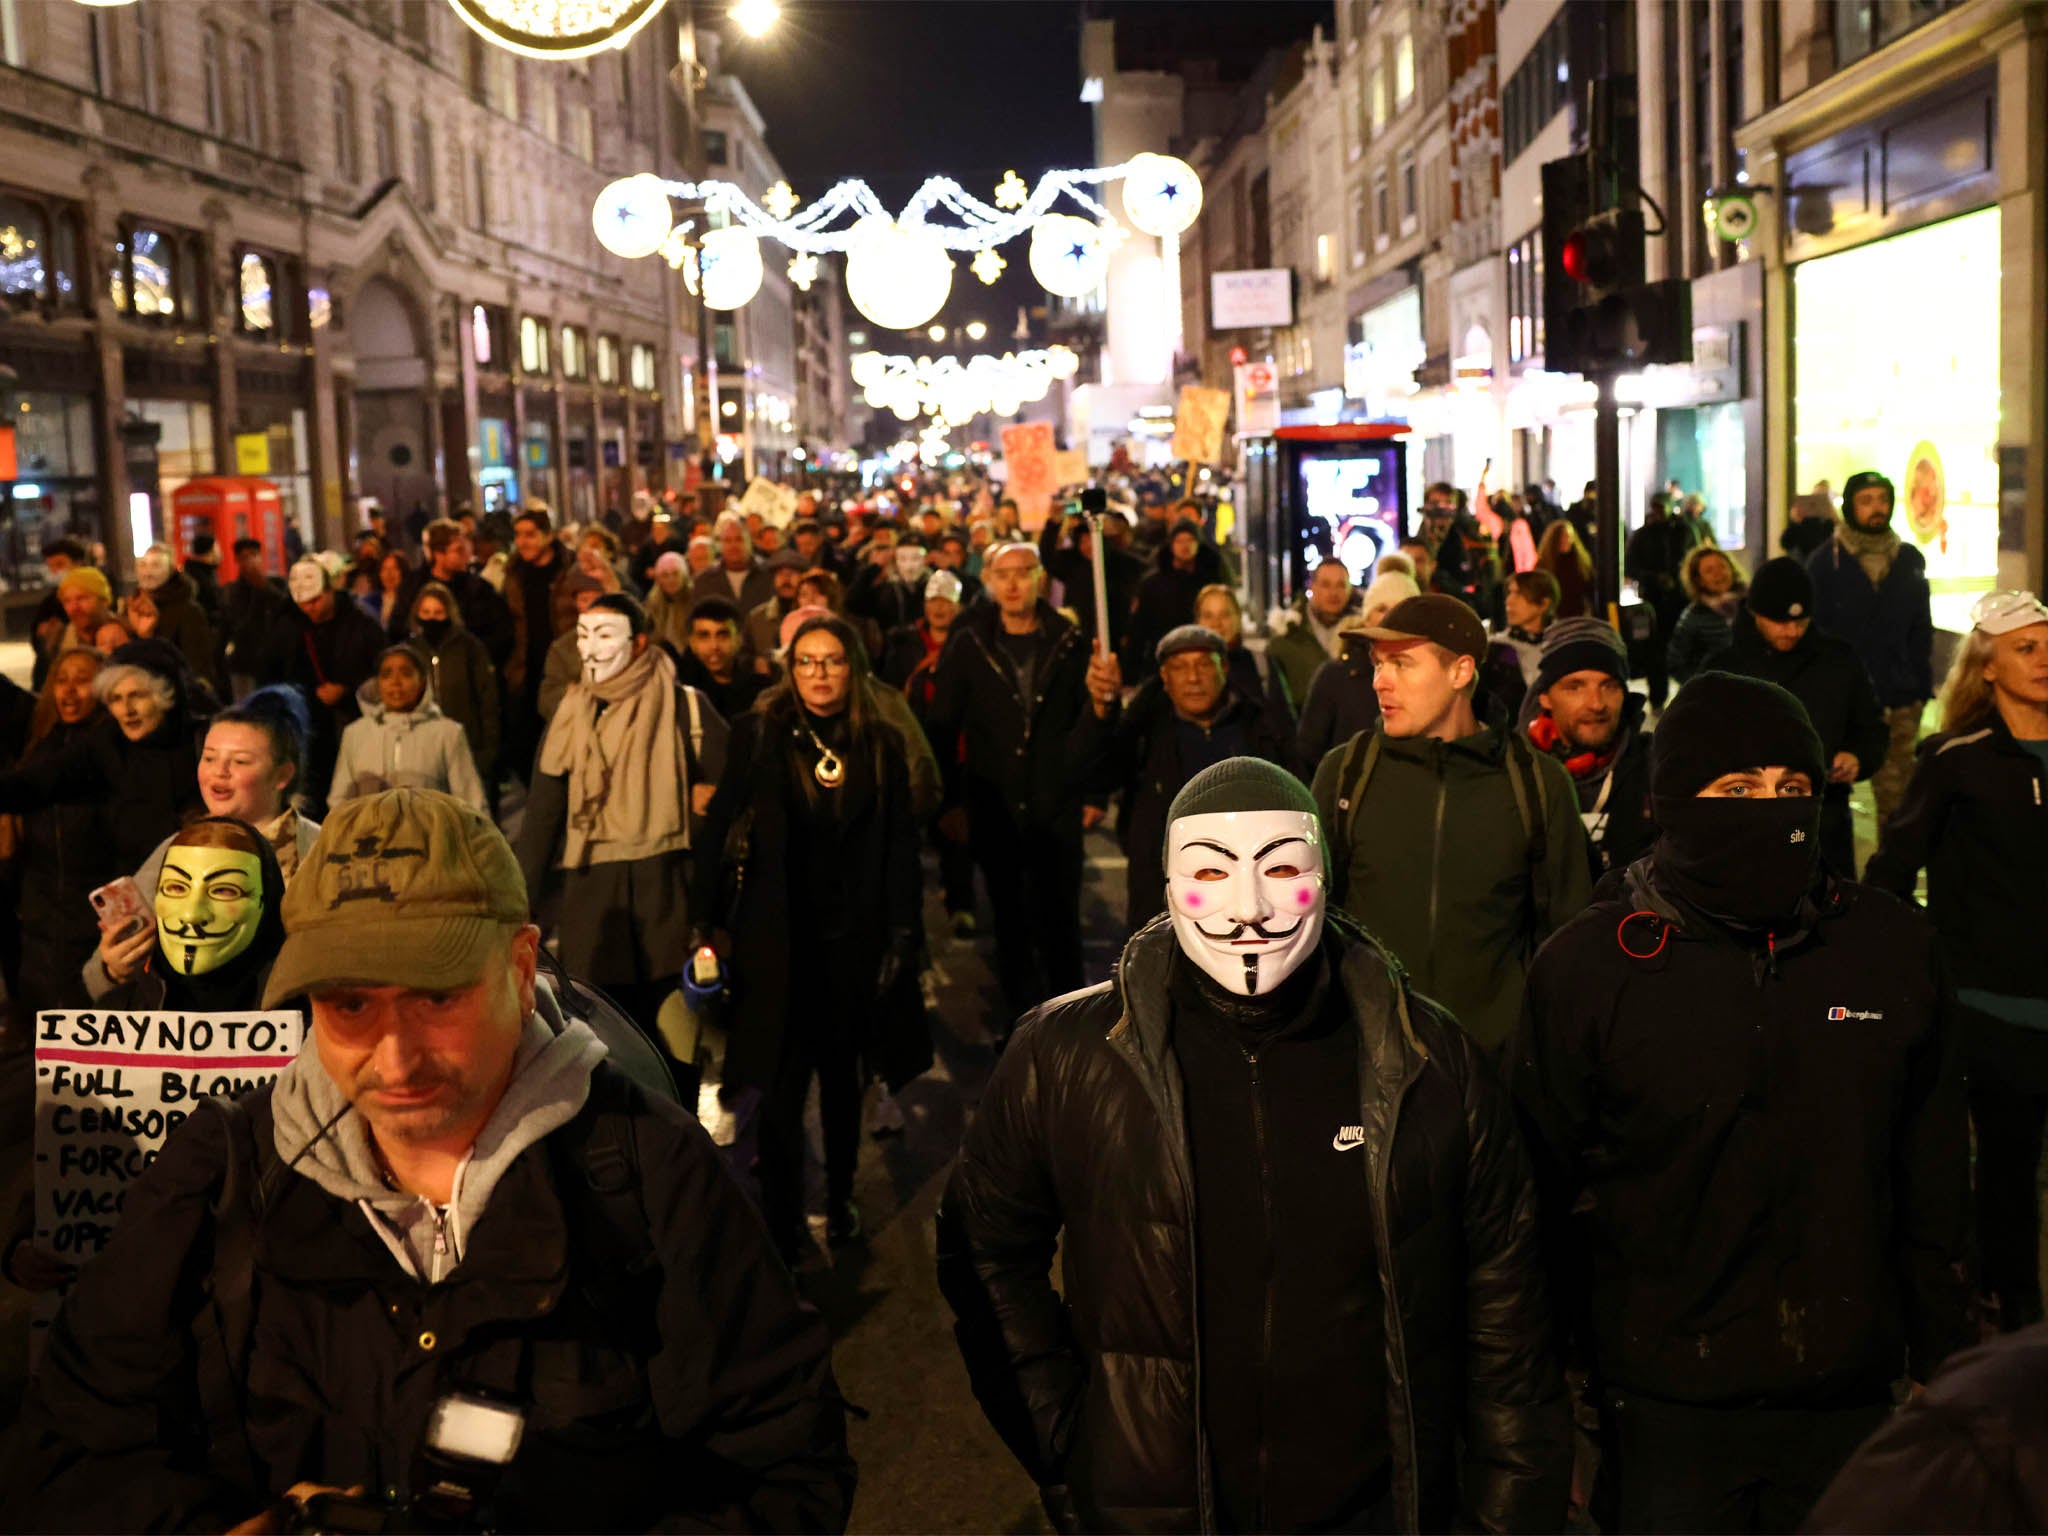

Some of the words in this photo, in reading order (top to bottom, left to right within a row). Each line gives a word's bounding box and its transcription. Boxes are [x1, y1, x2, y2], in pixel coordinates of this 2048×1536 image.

[1790, 829, 1806, 844] site
[41, 1014, 65, 1040] I
[72, 1014, 150, 1050] SAY
[158, 1015, 213, 1052] NO
[220, 1019, 288, 1052] TO:
